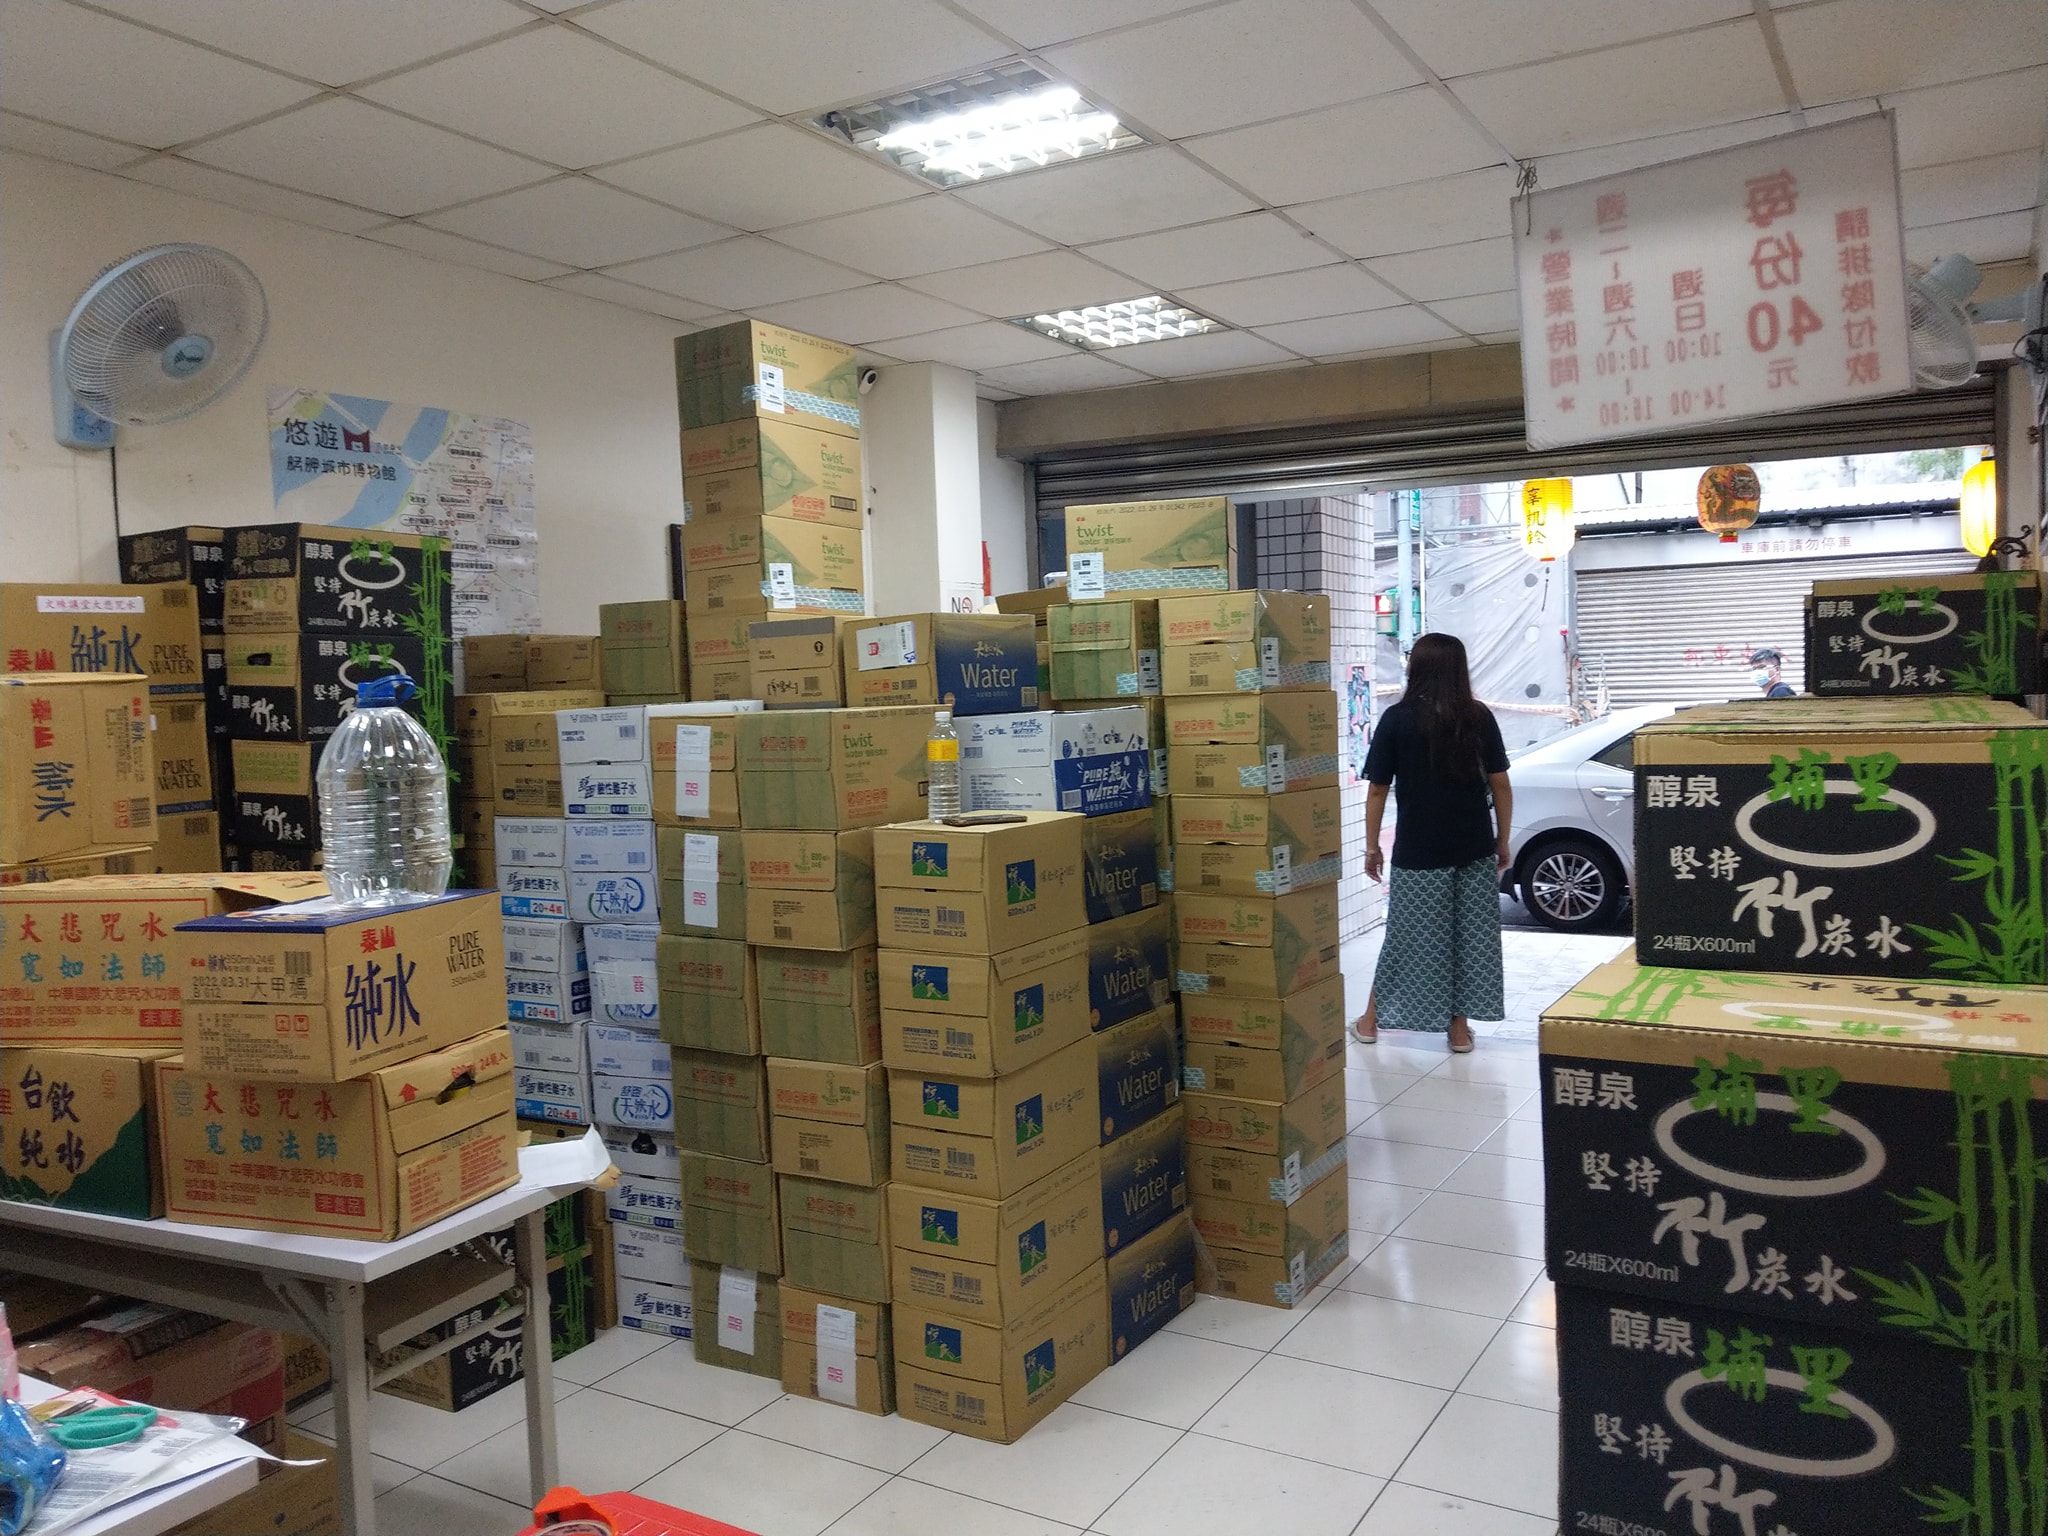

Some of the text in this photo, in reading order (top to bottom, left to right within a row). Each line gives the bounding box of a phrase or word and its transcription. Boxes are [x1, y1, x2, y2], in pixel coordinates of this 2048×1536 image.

[761, 341, 789, 359] twist
[284, 417, 339, 450] 悠遊
[286, 455, 398, 482] 艋舺城市博物館
[821, 450, 845, 465] twist
[1076, 523, 1114, 538] twist
[1740, 536, 1853, 555] 車庫前請勿停車
[192, 545, 224, 563] 醇泉
[304, 542, 335, 560] 醇泉
[350, 536, 395, 567] 埔里
[822, 542, 845, 557] twist
[313, 576, 343, 594] 堅持
[336, 588, 399, 629] 竹炭水
[1818, 600, 1855, 618] 醇泉
[1878, 585, 1941, 616] 埔里
[71, 625, 145, 674] 純水
[153, 644, 189, 660] PURE
[318, 640, 348, 657] 醇泉
[350, 641, 395, 669] 埔里
[1828, 634, 1865, 653] 堅持
[7, 648, 56, 672] 泰山
[150, 660, 196, 675] WATER
[1859, 645, 1945, 689] 竹炭水
[960, 662, 1018, 689] Water
[313, 684, 343, 702] 堅持
[842, 733, 874, 749] twist
[157, 773, 202, 790] WATER
[160, 758, 195, 776] PURE
[1083, 767, 1110, 783] PURE
[1767, 747, 1901, 813] 埔里
[31, 761, 76, 822] 純水
[1085, 784, 1119, 802] WATER
[1646, 774, 1721, 808] 醇泉
[1669, 845, 1741, 882] 堅持
[1087, 866, 1138, 897] Water
[595, 893, 636, 914] 天然水
[1732, 870, 1912, 958] 竹炭水
[19, 911, 168, 944] 大悲咒水
[360, 925, 396, 954] 泰山
[449, 930, 480, 954] PURE
[1653, 934, 1756, 954] 24瓶X600ml
[446, 948, 485, 974] WATER
[1103, 965, 1151, 1000] Water
[344, 952, 421, 1051] 純水
[19, 1063, 81, 1124] 台飲
[1117, 1066, 1163, 1106] Water
[1551, 1066, 1639, 1112] 醇泉
[1690, 1052, 1844, 1136] 埔里
[202, 1082, 338, 1122] 大悲咒水
[620, 1097, 662, 1120] 天然水
[1582, 1150, 1662, 1198] 堅持
[1122, 1171, 1170, 1216] Water
[1653, 1191, 1857, 1306] 竹炭水
[1564, 1250, 1680, 1284] 24瓶X600ml
[1130, 1272, 1178, 1323] Water
[1609, 1308, 1696, 1358] 醇泉
[1700, 1326, 1854, 1419] 埔里
[1593, 1412, 1673, 1465] 堅持
[1664, 1464, 1777, 1536] 竹
